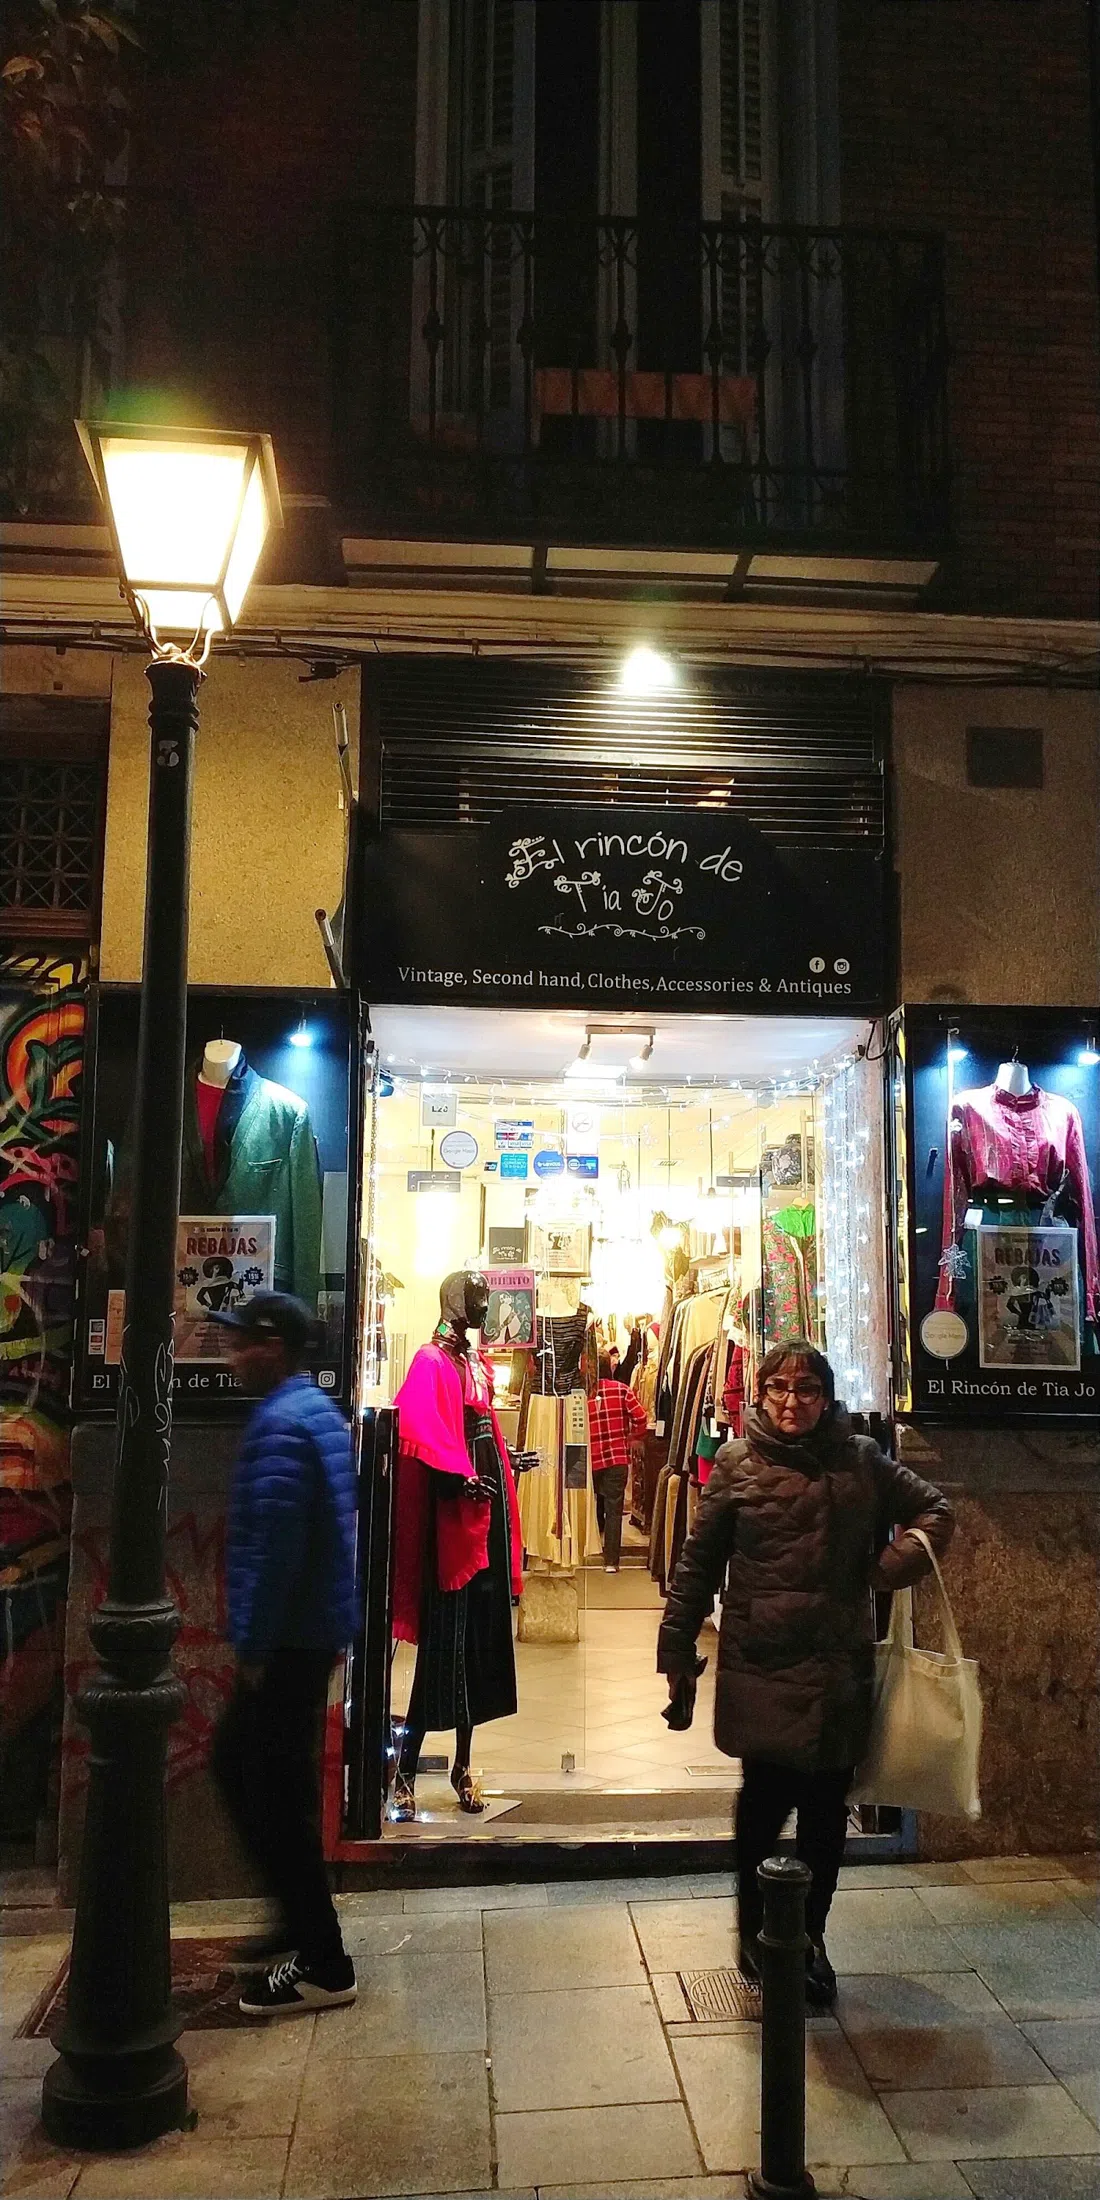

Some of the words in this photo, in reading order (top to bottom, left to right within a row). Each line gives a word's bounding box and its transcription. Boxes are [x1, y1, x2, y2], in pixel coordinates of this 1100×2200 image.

[504, 835, 565, 888] El
[574, 831, 688, 863] rincón
[699, 846, 743, 882] de
[631, 870, 683, 920] Jo
[398, 966, 468, 987] Vintage,
[472, 968, 533, 986] Second
[538, 970, 585, 990] hand,
[588, 972, 655, 992] Clothes,
[655, 976, 754, 993] Accessories
[758, 978, 772, 993] &
[776, 978, 852, 998] Antiques
[186, 1237, 258, 1257] REBAJAS
[490, 1275, 530, 1286] BIERTO
[92, 1374, 110, 1389] El
[188, 1375, 210, 1388] de
[216, 1373, 243, 1388] Tia
[927, 1379, 945, 1394] El
[951, 1380, 1011, 1396] Rincón
[1017, 1381, 1038, 1396] de
[1042, 1382, 1070, 1397] Tia
[1074, 1382, 1096, 1397] Jo
